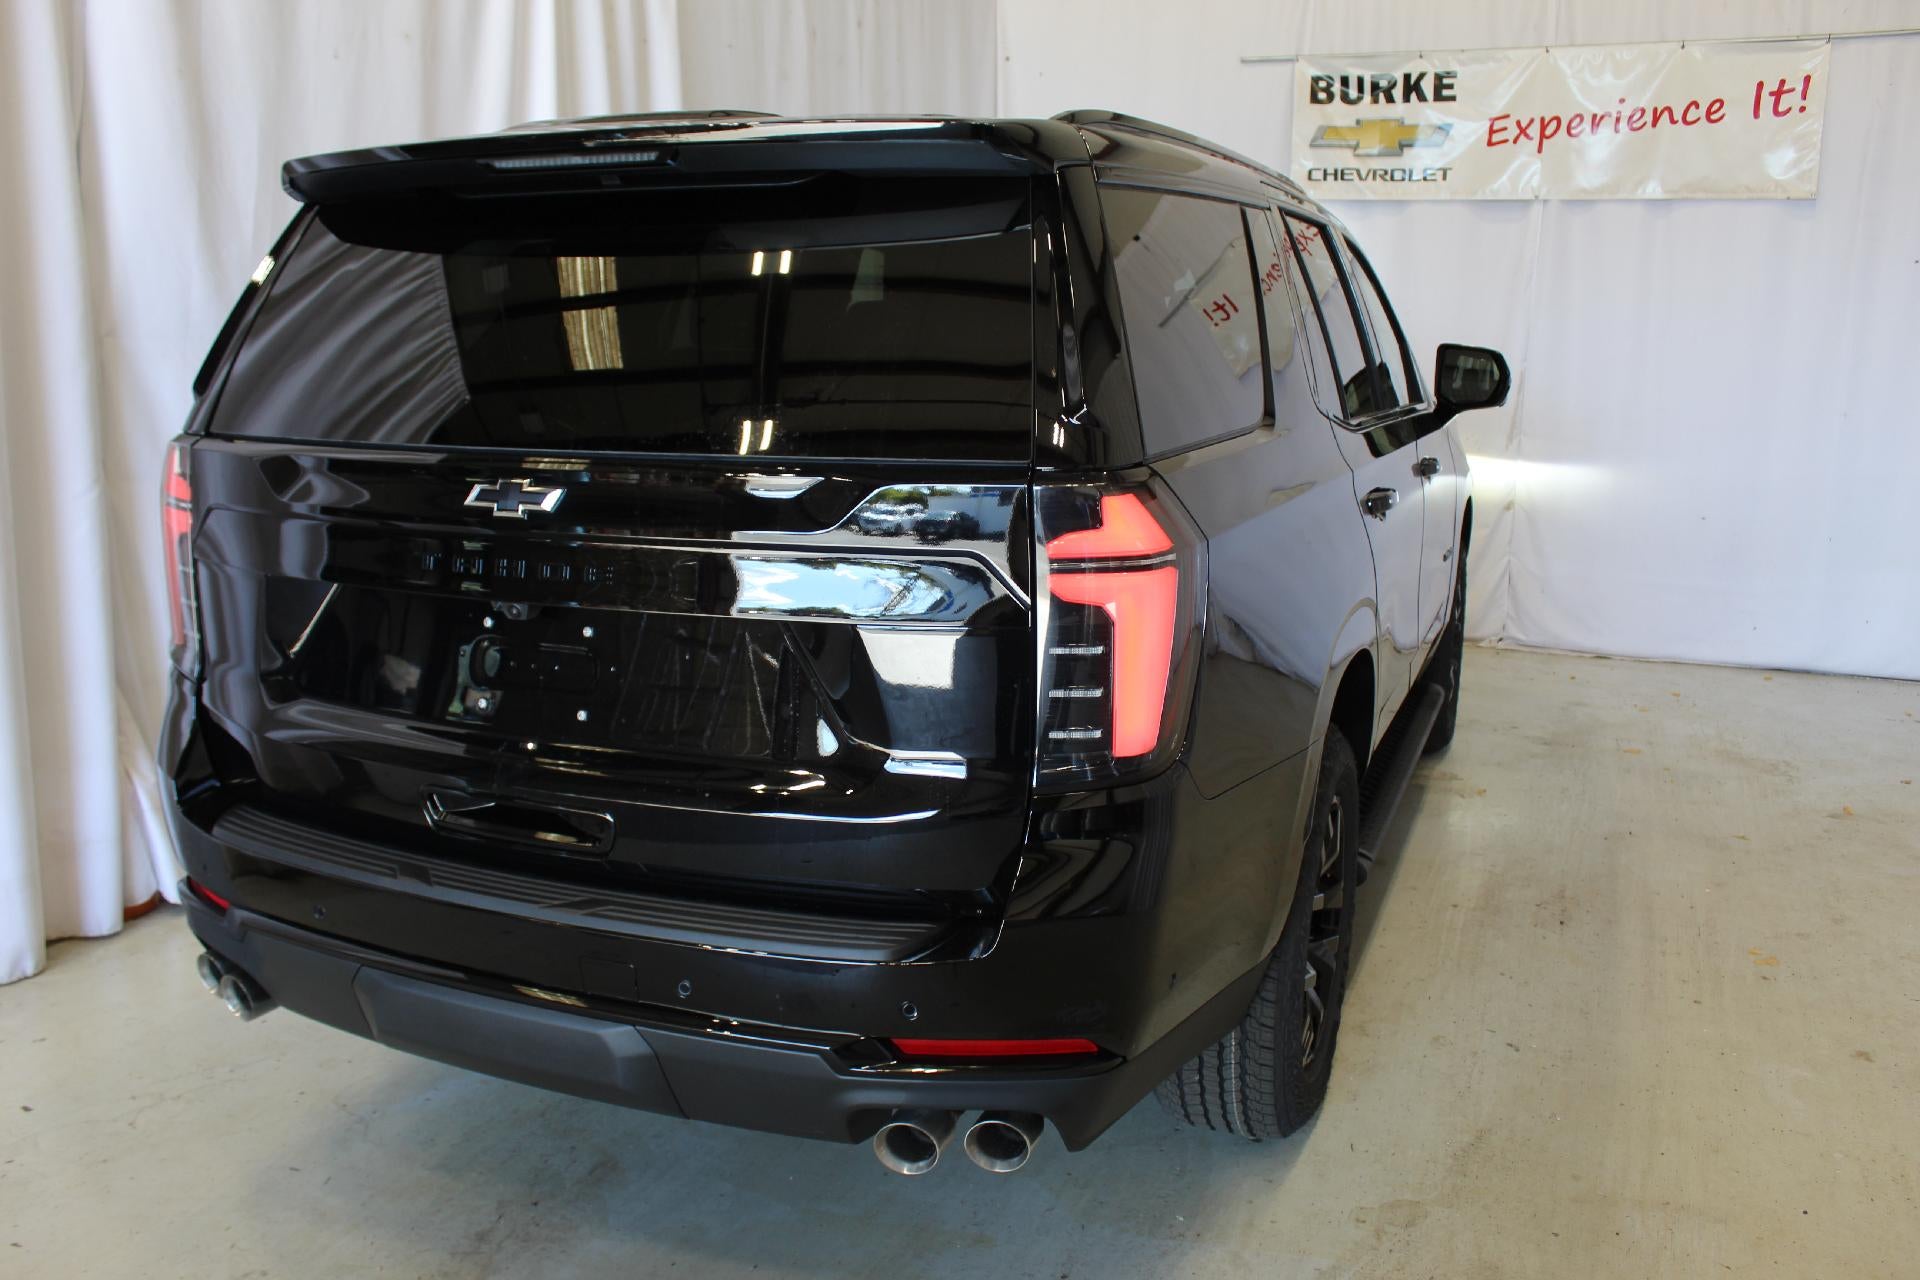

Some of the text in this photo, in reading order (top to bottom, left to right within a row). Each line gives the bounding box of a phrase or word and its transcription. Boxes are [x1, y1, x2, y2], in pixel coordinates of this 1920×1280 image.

[1309, 71, 1458, 106] BURKE
[1486, 74, 1812, 153] Experience It!
[1307, 167, 1453, 182] CHEVROLET
